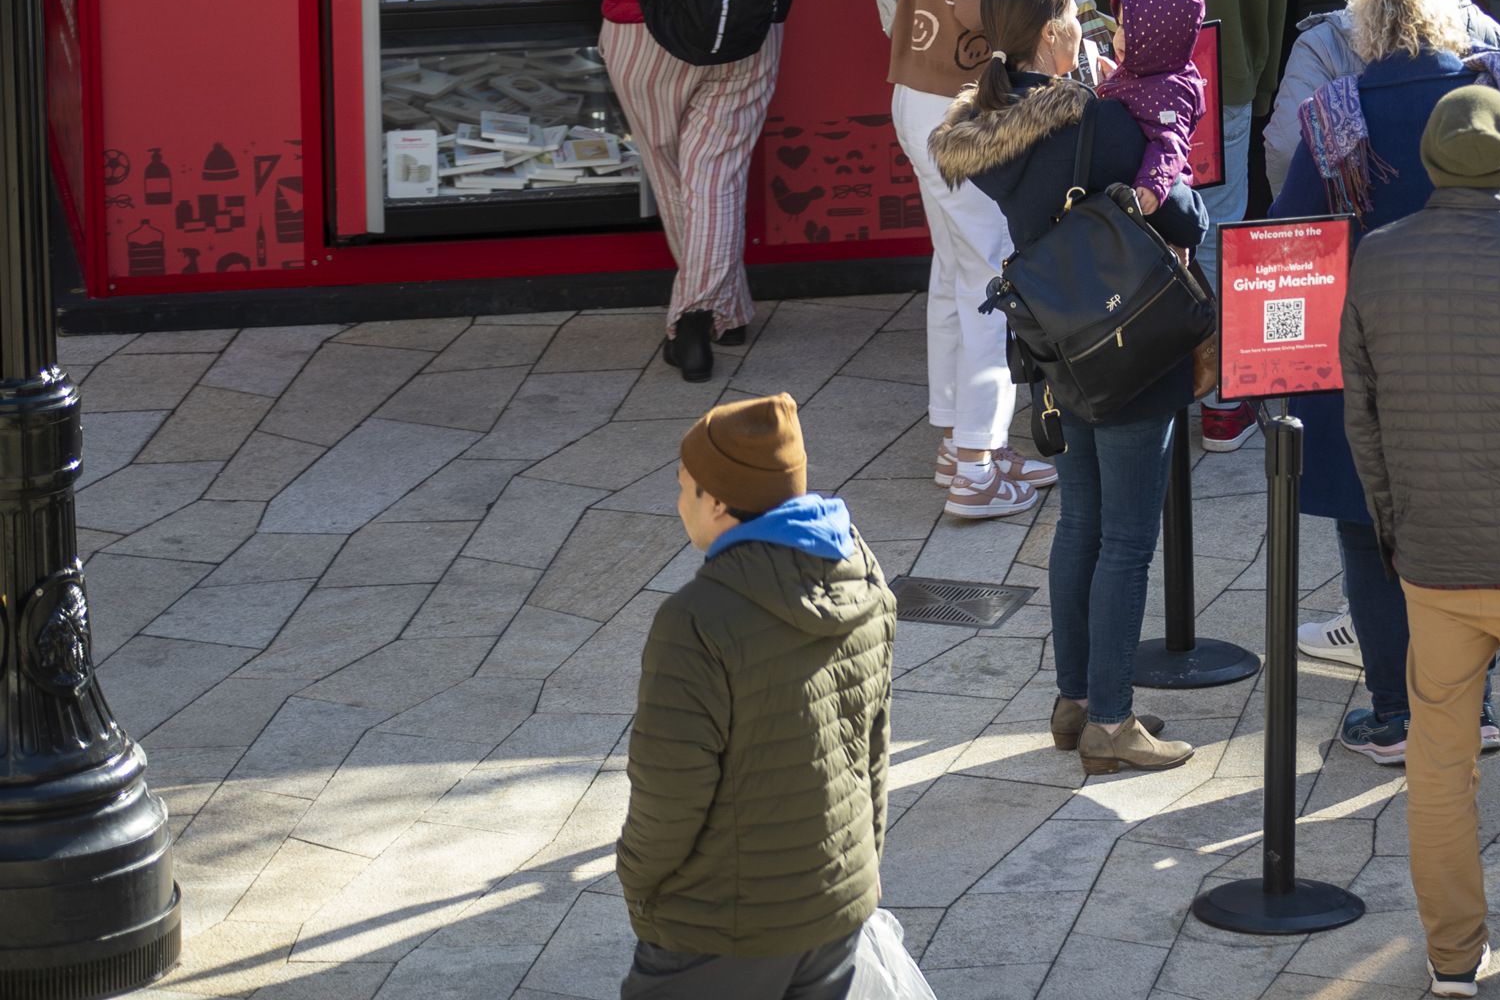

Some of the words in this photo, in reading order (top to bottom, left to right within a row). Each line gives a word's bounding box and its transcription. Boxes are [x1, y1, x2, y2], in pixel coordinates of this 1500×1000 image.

[1250, 230, 1293, 240] Welcome
[1294, 229, 1304, 237] to
[1306, 227, 1322, 237] the
[1256, 262, 1313, 275] LightTheWorld
[1233, 278, 1276, 293] Giving
[1278, 273, 1335, 289] Machine
